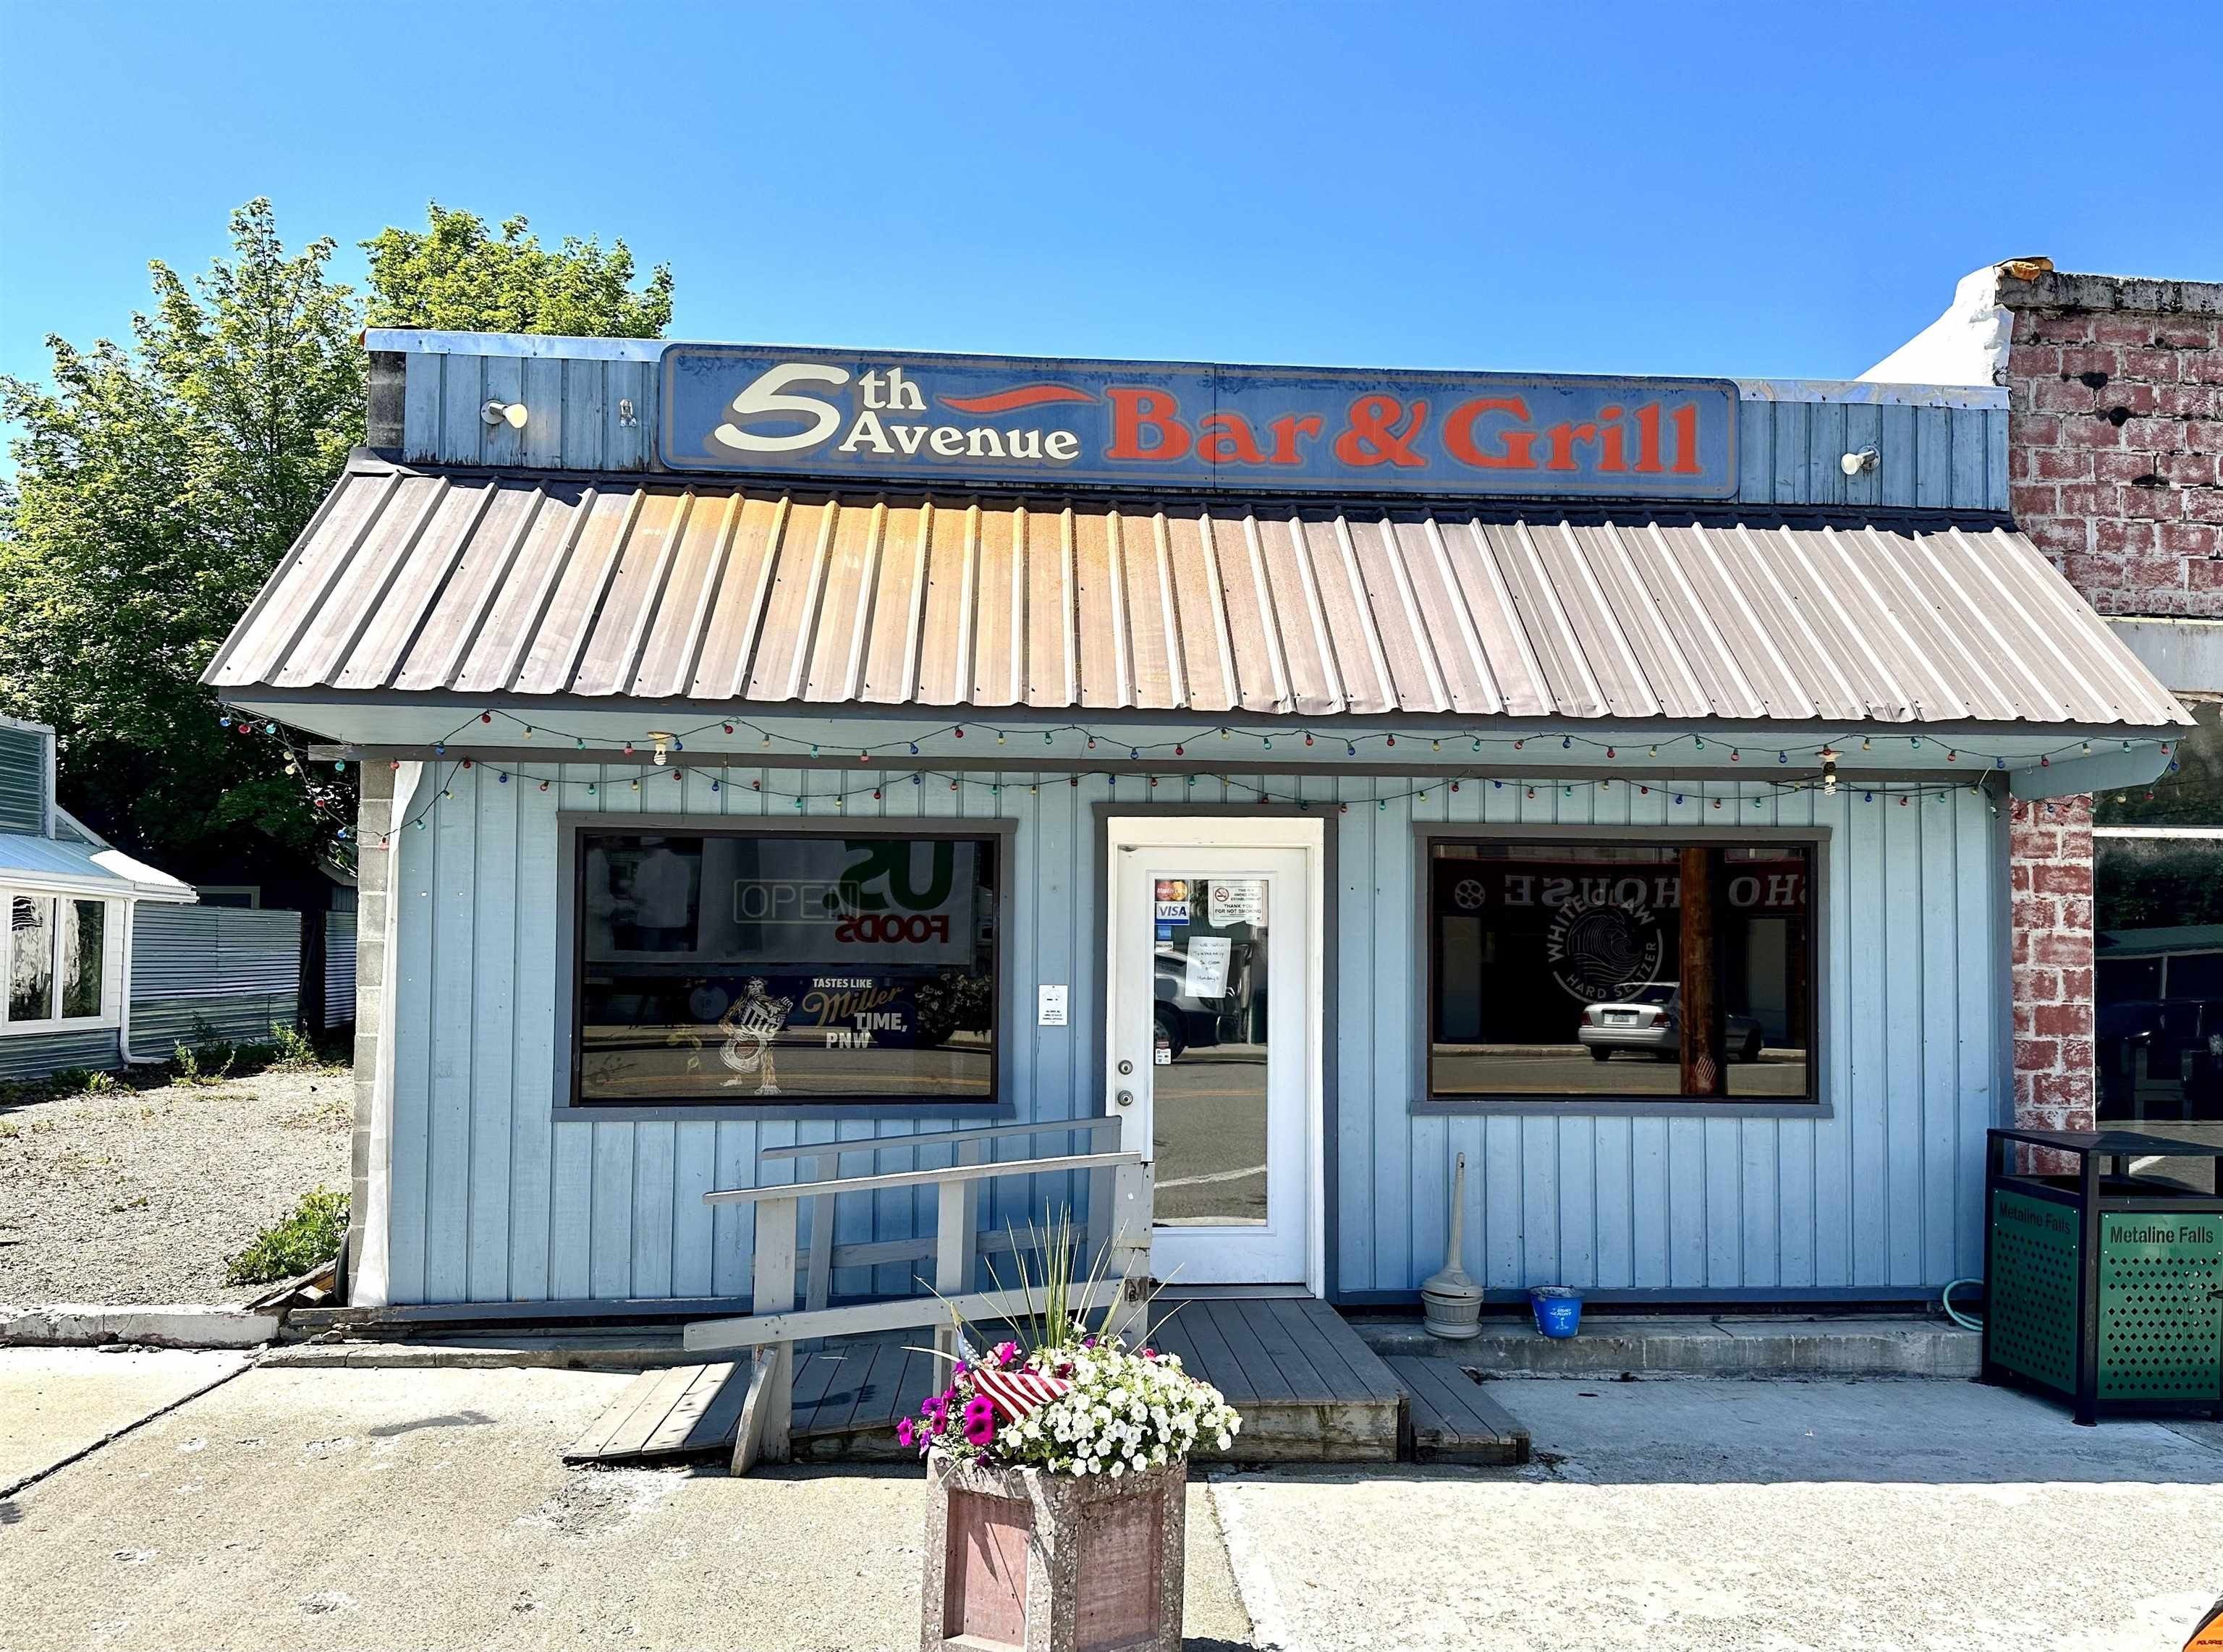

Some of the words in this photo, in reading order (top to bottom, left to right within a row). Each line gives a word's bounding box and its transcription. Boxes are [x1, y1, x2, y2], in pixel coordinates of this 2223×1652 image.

[838, 411, 1080, 460] Avenue
[1104, 389, 1324, 465] Bar
[1334, 394, 1429, 467] &
[1444, 396, 1703, 475] Grill
[741, 884, 853, 919] OPEN
[1159, 906, 1187, 916] VISA
[1546, 894, 1588, 963] WHITE
[813, 978, 848, 988] TASTES
[850, 978, 873, 988] LIKE
[1566, 973, 1606, 999] HARD
[802, 986, 904, 1029] Miller
[854, 1012, 907, 1033] TIME,
[826, 1032, 871, 1049] PNW
[1999, 1201, 2043, 1227] Metaline
[2045, 1213, 2071, 1234] Falls
[2110, 1226, 2175, 1243] Metaline
[2180, 1226, 2214, 1243] Falls
